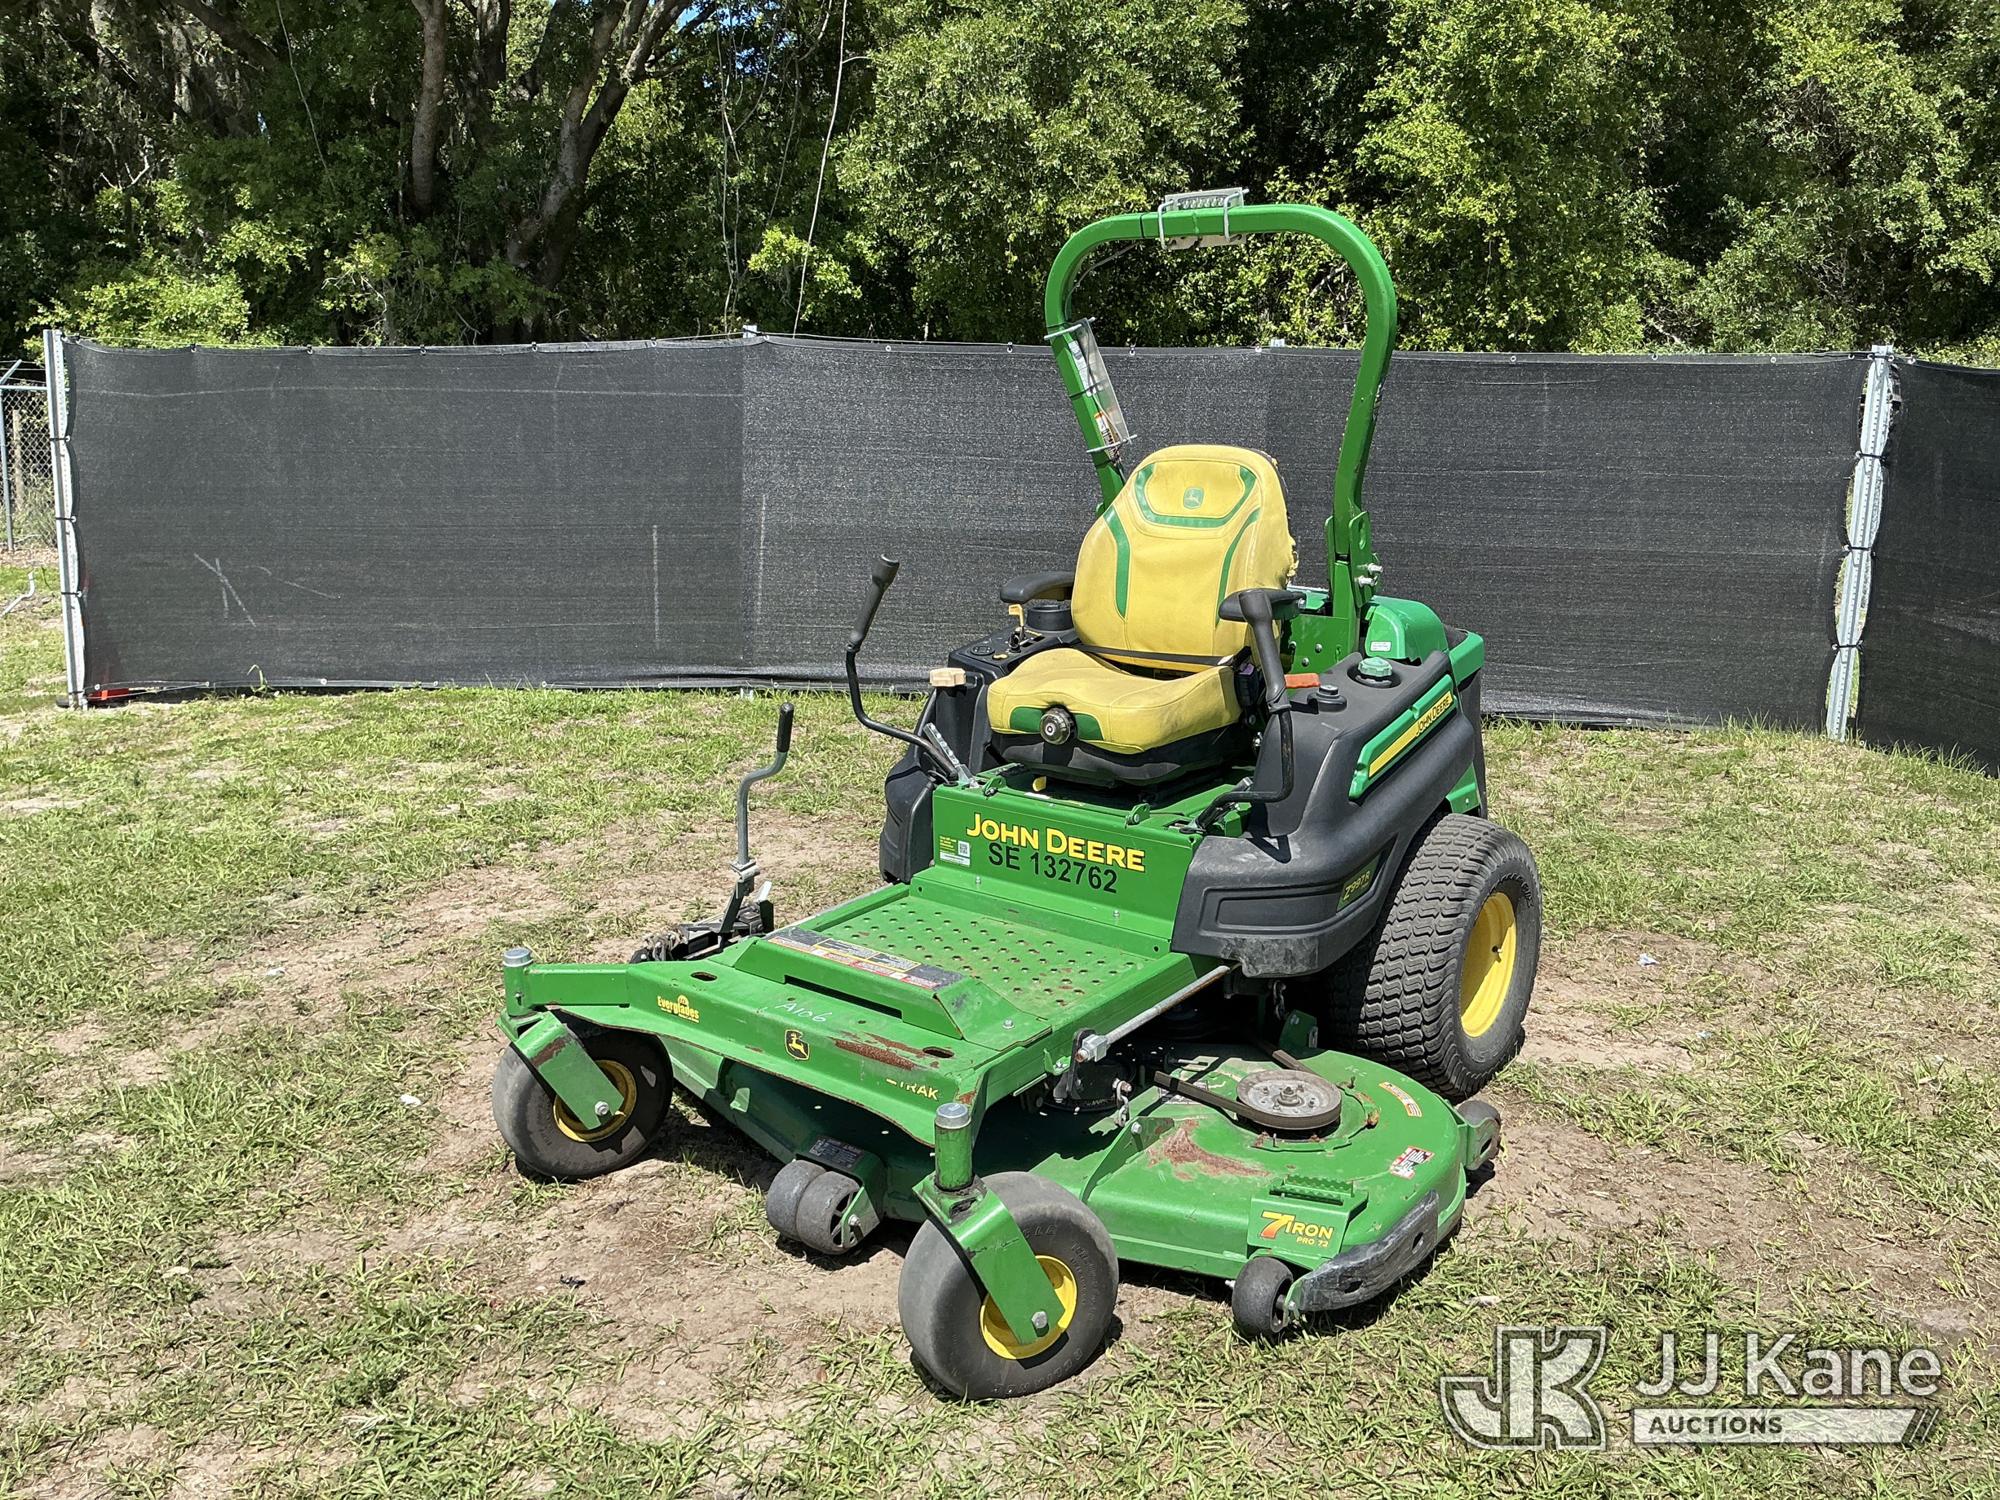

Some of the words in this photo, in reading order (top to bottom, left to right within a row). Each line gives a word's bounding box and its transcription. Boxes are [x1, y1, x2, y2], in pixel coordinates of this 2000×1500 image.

[966, 812, 1039, 850] JOHN
[1046, 828, 1145, 873] DEERE
[988, 842, 1020, 871] SE
[1030, 852, 1118, 894] 132762
[1296, 1236, 1315, 1246] PRO
